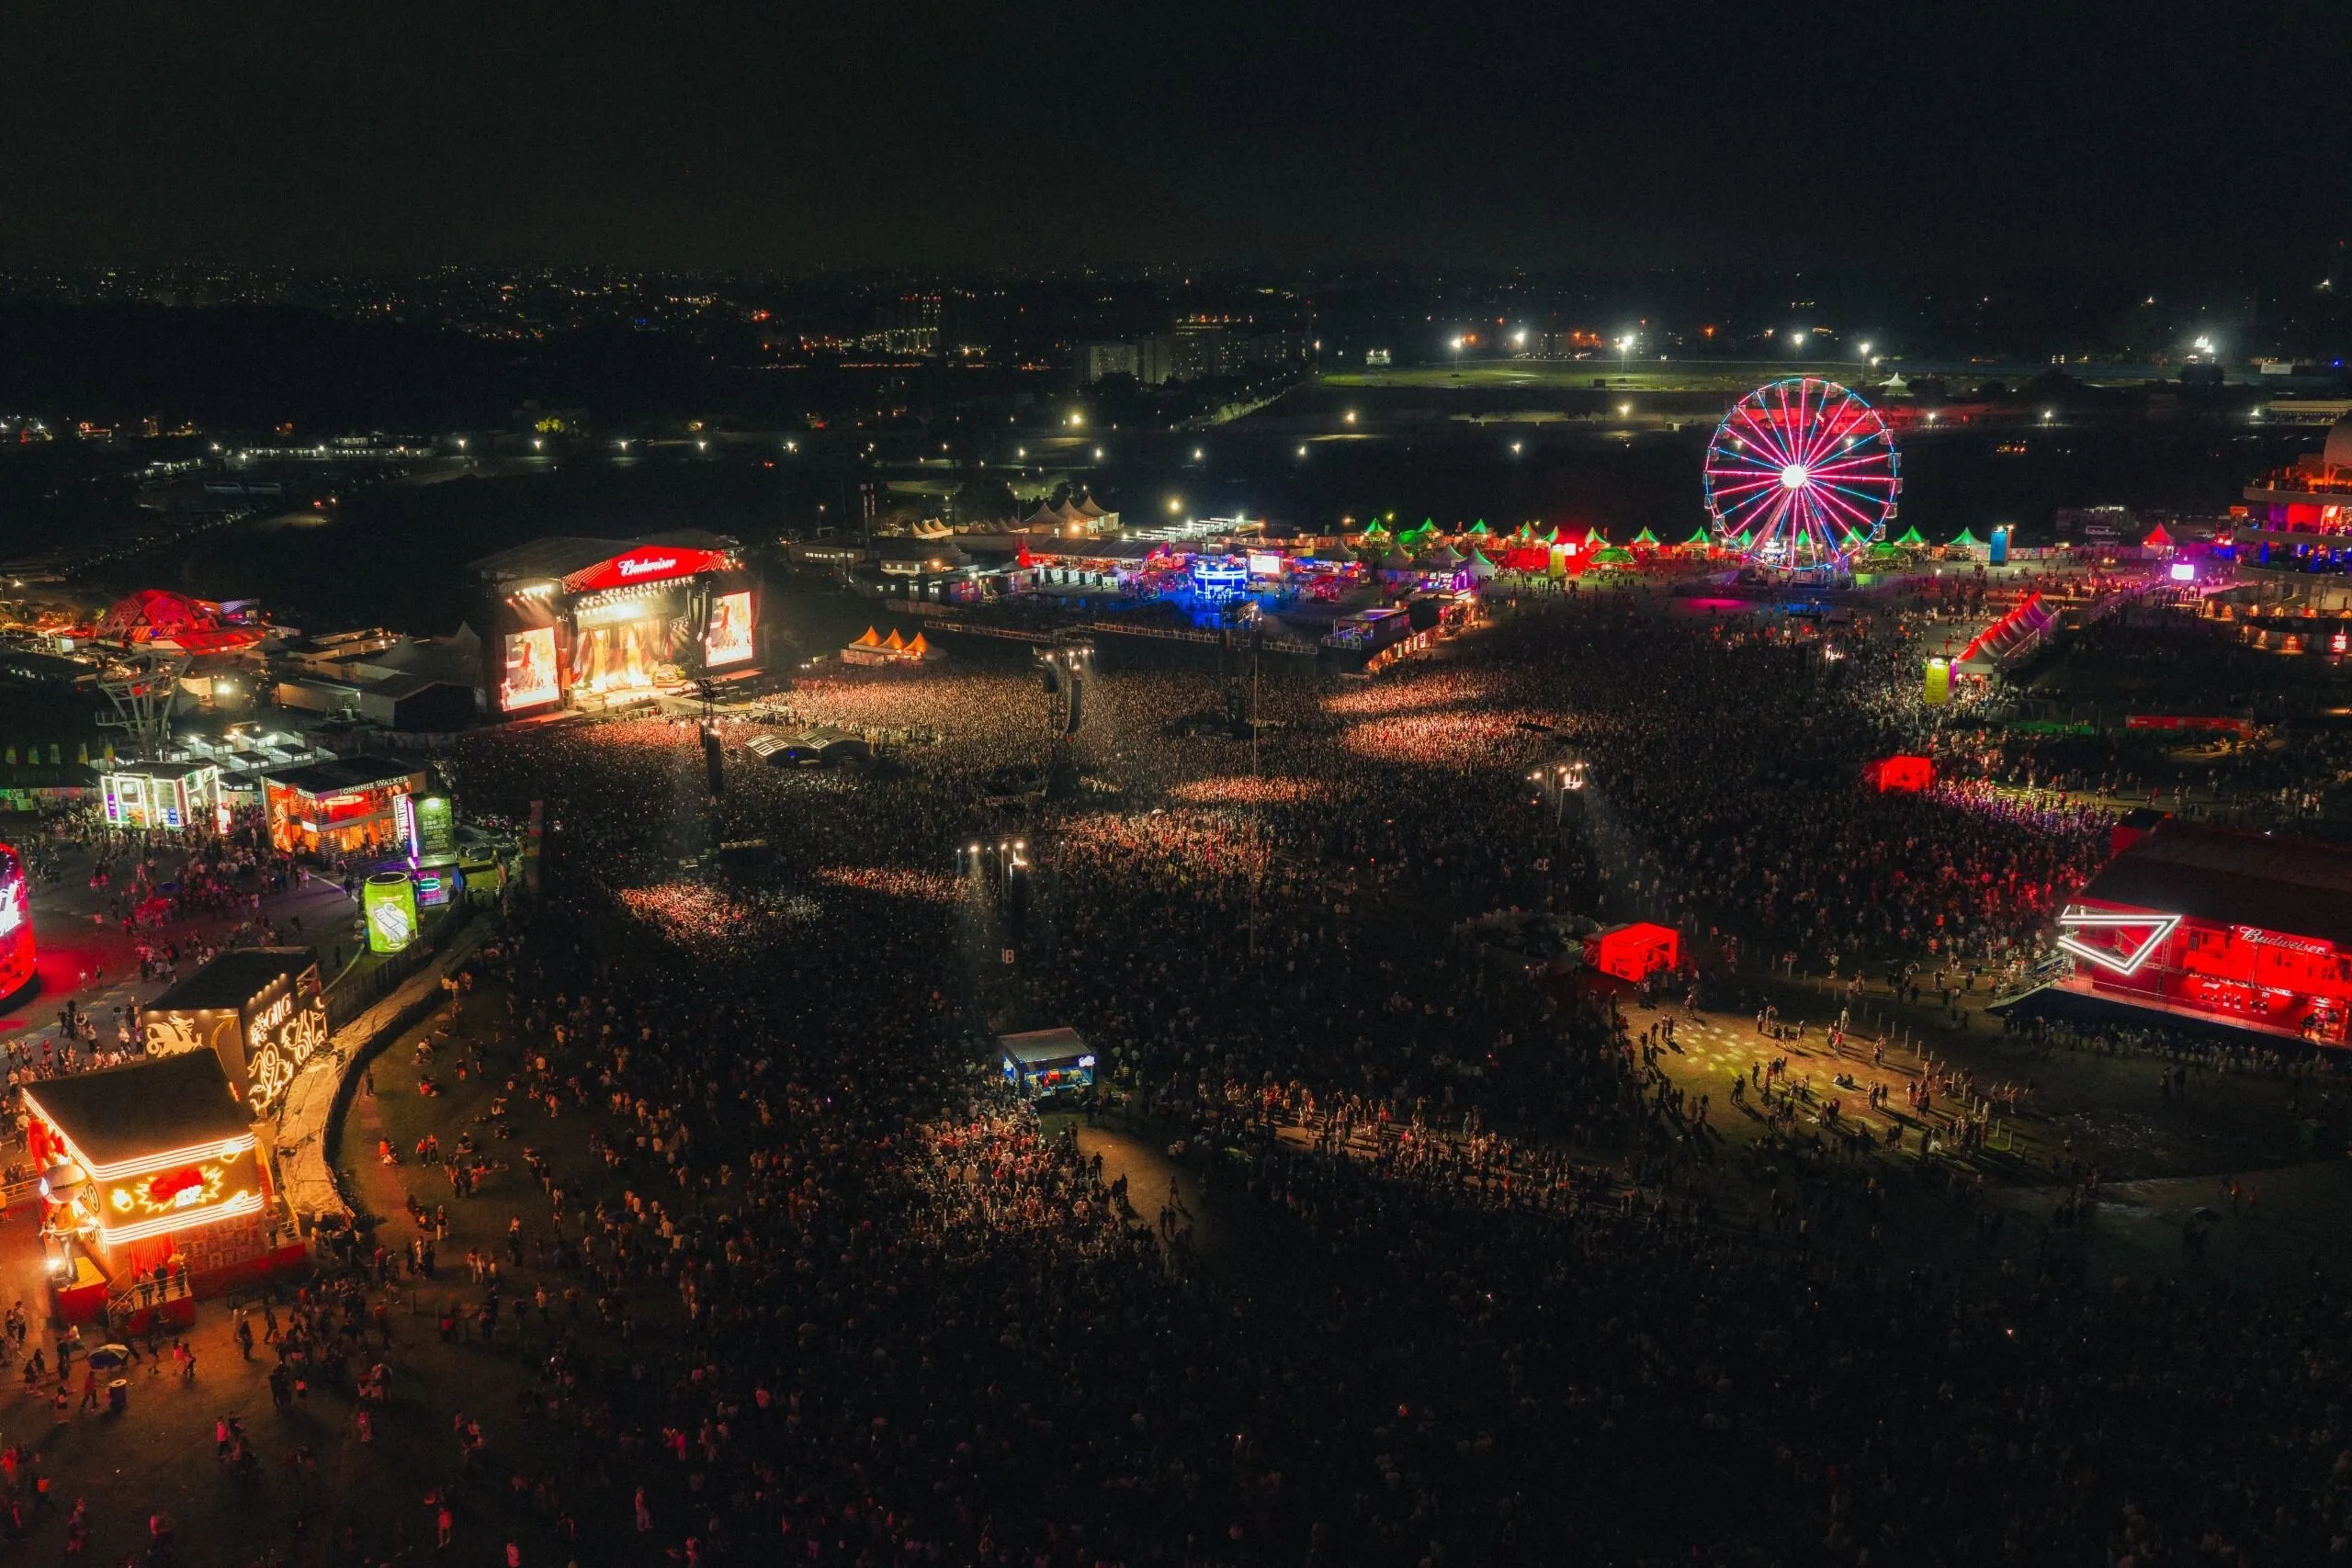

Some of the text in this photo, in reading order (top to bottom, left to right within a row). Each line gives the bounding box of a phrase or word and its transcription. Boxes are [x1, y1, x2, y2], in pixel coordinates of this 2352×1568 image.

[618, 558, 676, 576] Budweiser
[340, 775, 409, 796] JOHNNIE WALKER
[2239, 926, 2326, 954] Budweiser
